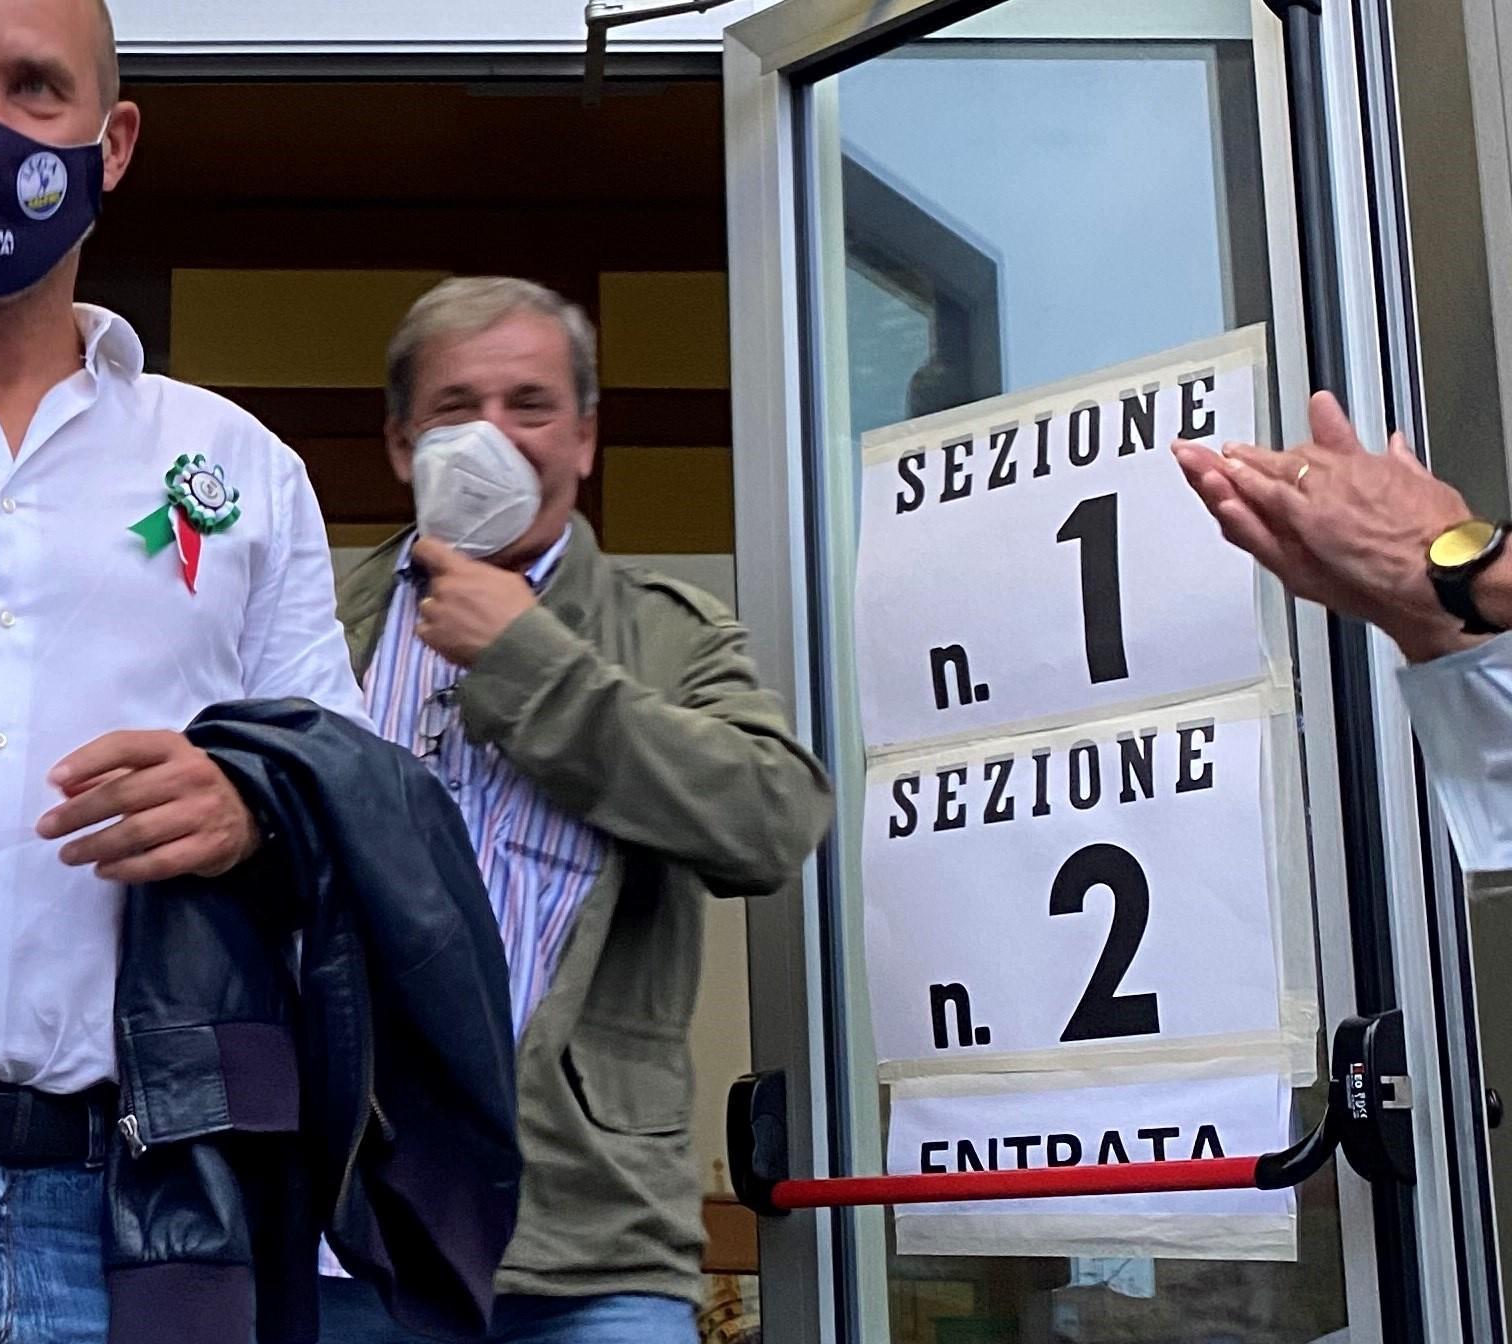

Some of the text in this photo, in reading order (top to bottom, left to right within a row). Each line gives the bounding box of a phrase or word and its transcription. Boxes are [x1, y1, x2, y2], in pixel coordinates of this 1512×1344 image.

[895, 367, 1216, 515] SEZIONE
[928, 492, 1130, 710] n. 1
[888, 717, 1215, 839] SEZIONE
[928, 842, 1161, 1049] n. 2
[920, 1124, 1226, 1174] ENTRATA
